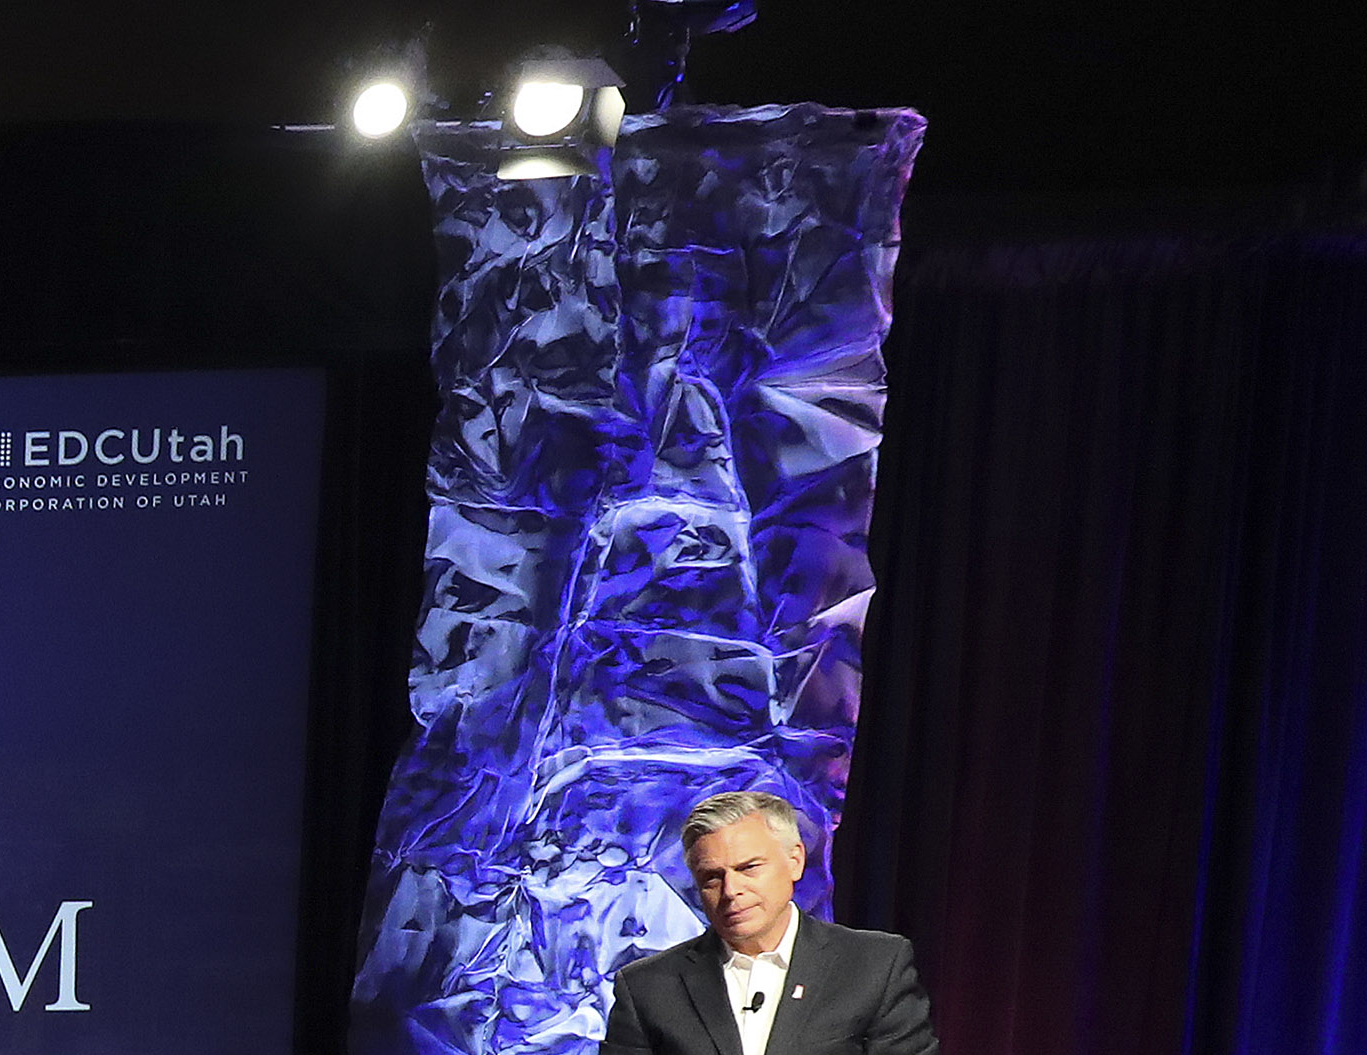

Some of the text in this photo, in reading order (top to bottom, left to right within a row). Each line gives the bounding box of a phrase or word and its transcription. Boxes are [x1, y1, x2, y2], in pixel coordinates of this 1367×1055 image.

[24, 425, 245, 466] EDCUtah
[97, 471, 249, 487] DEVELOPMENT
[136, 495, 162, 508] OF
[174, 493, 227, 507] UTAH
